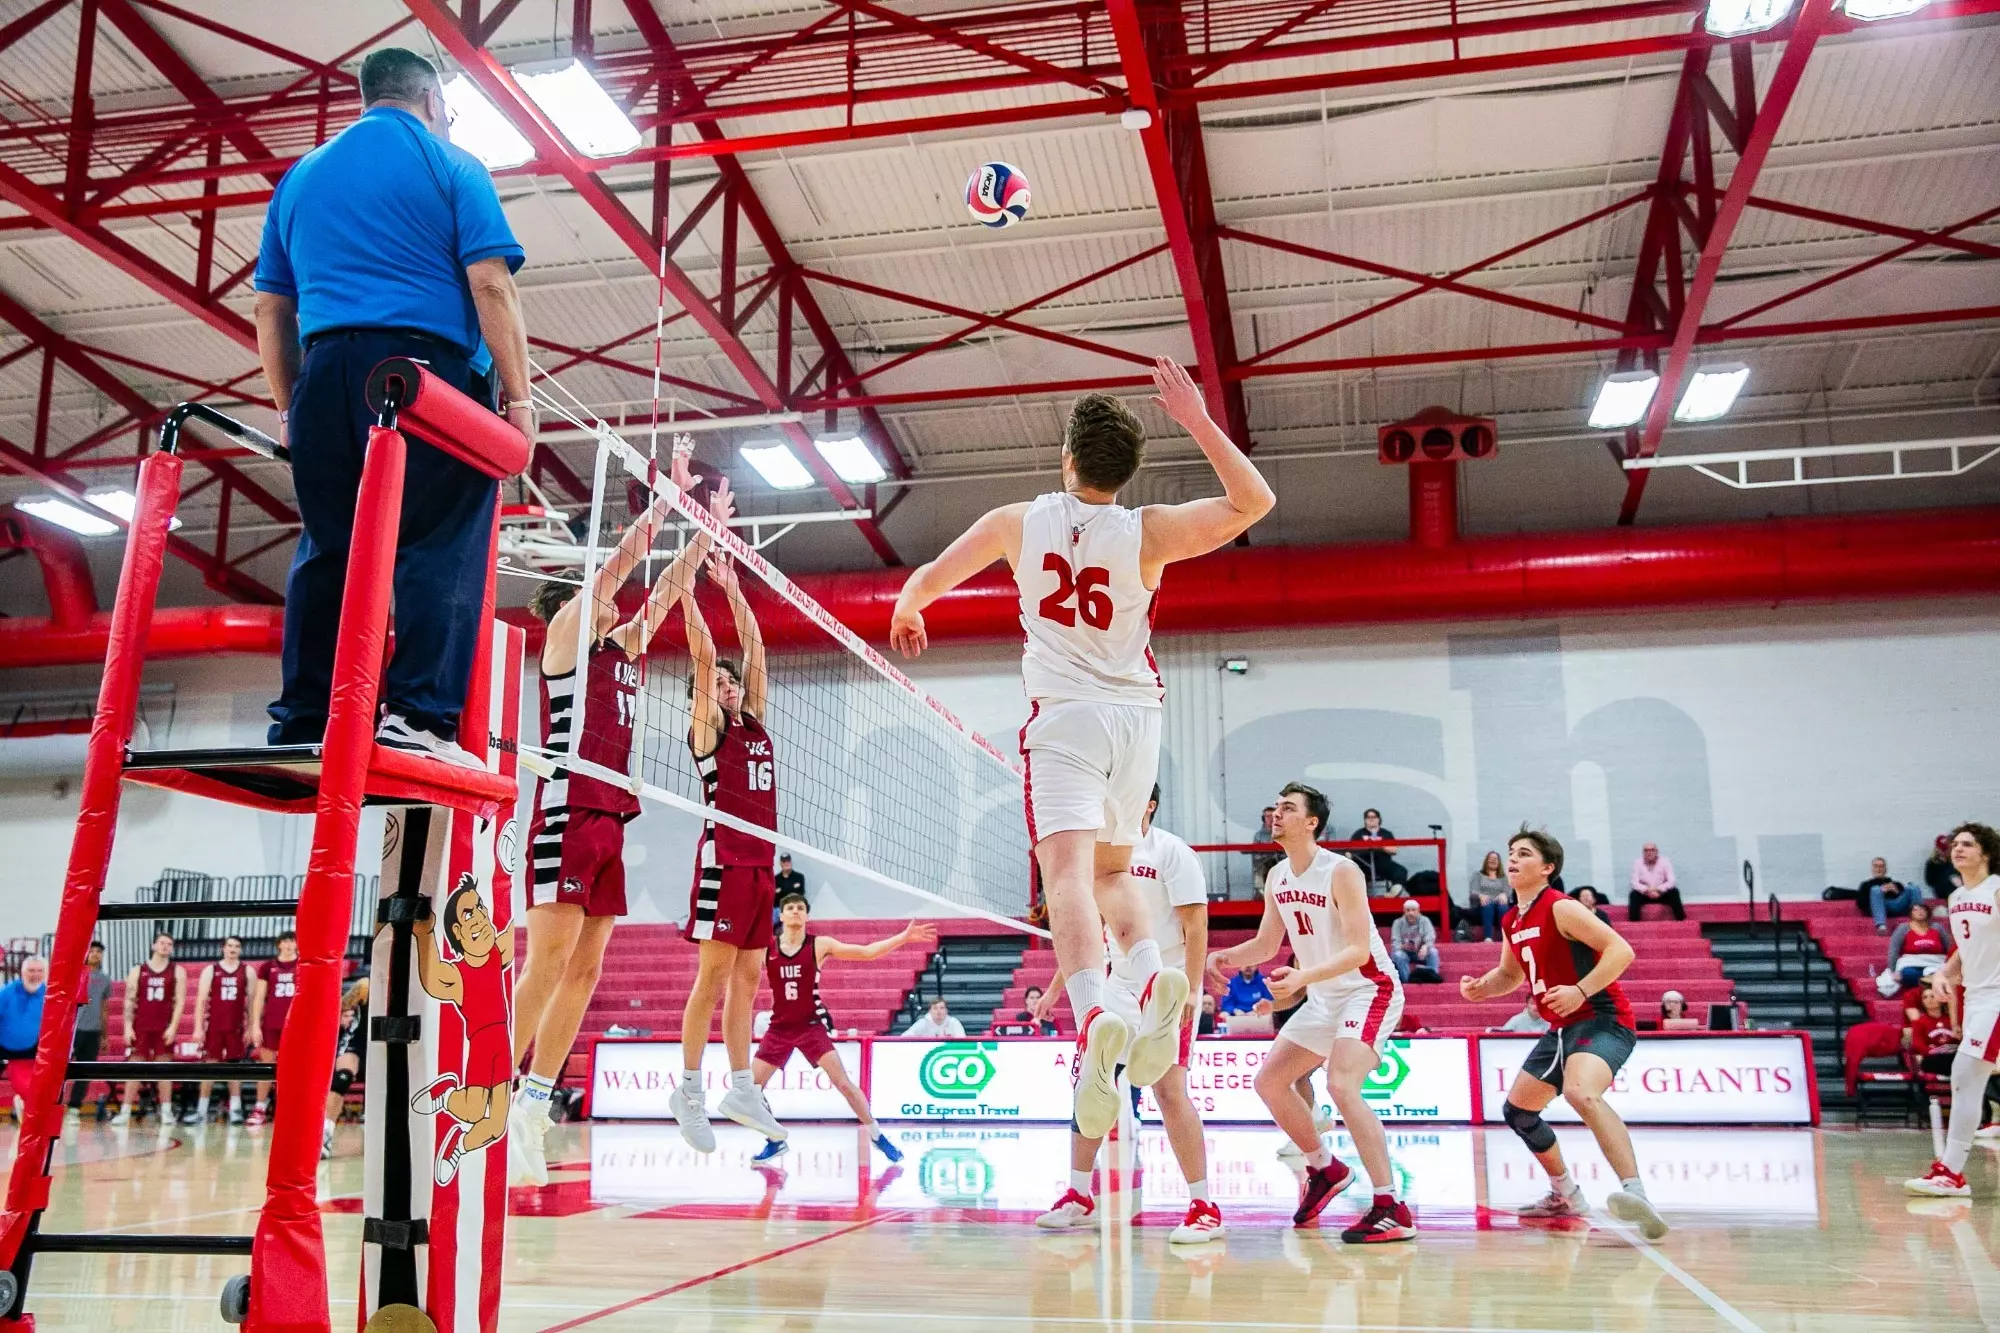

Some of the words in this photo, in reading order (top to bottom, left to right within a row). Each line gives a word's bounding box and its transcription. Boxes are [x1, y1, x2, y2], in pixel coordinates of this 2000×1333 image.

[982, 173, 994, 196] NCAA
[1039, 553, 1113, 631] 26
[748, 761, 772, 791] 16
[1961, 919, 1970, 939] 3
[780, 965, 802, 978] IUE
[785, 981, 798, 1000] 6
[602, 1070, 713, 1091] WABA
[932, 1055, 986, 1085] GO
[1642, 1067, 1793, 1093] GIANTS
[901, 1103, 922, 1115] GO
[926, 1103, 976, 1119] Express
[978, 1103, 1020, 1116] Travel
[1393, 1104, 1439, 1116] Travel
